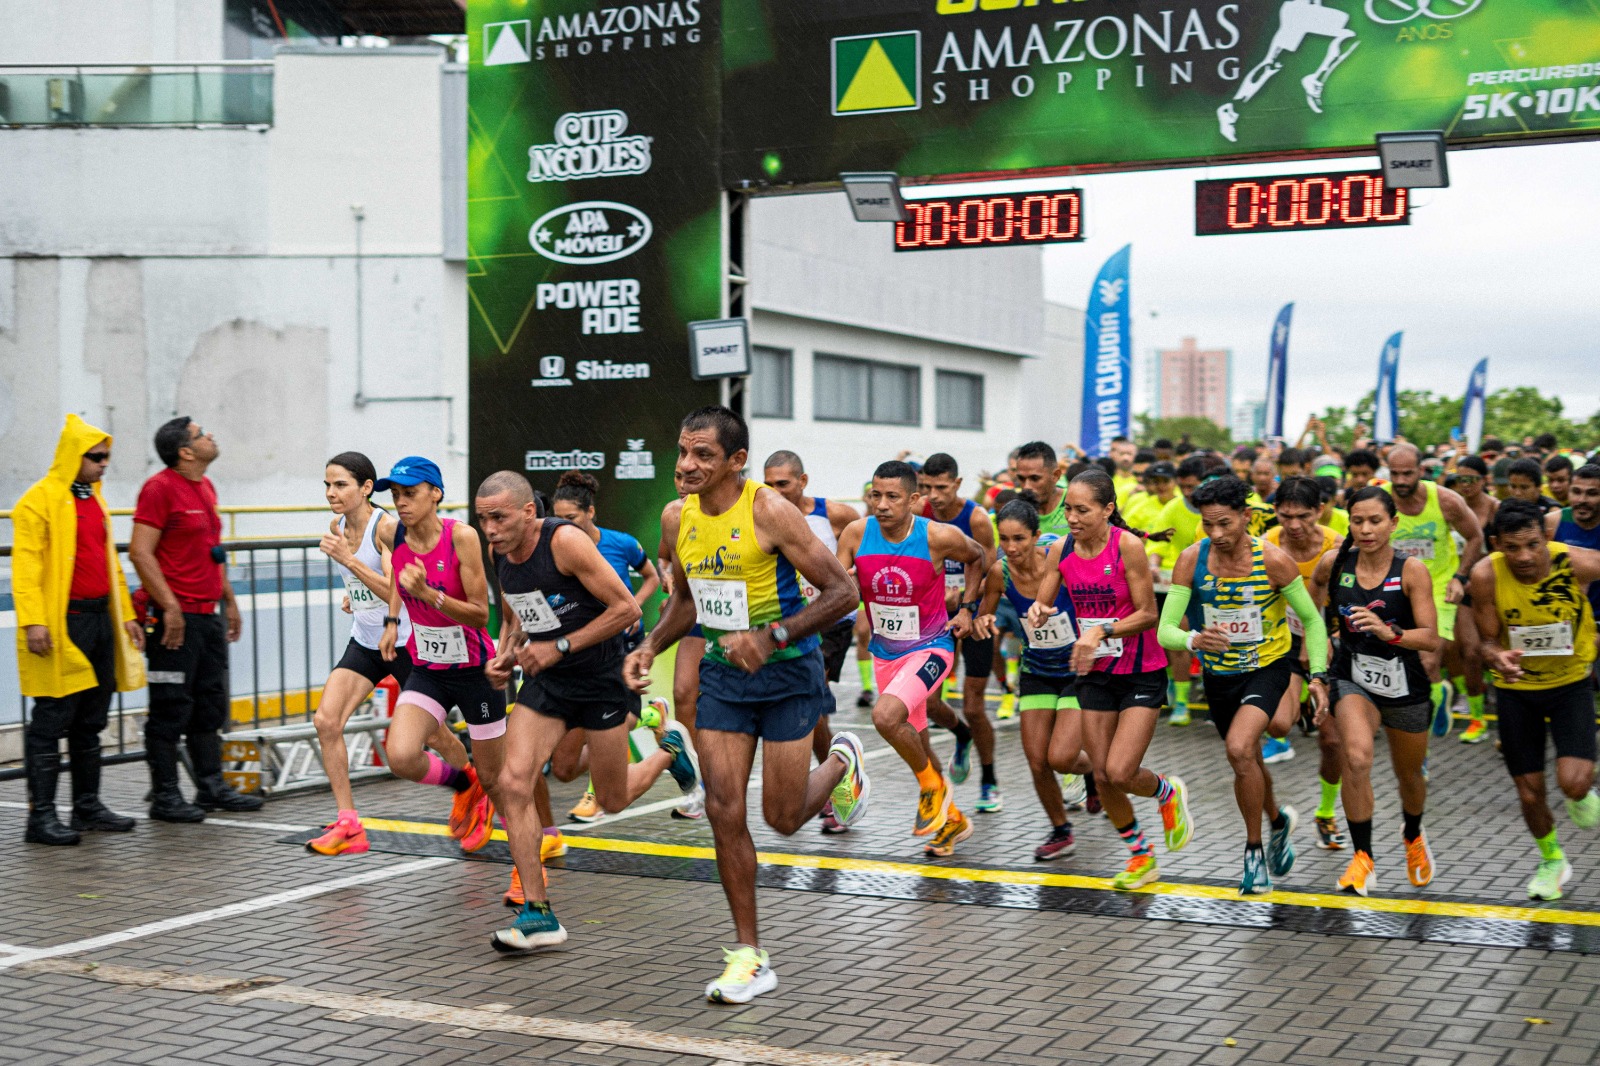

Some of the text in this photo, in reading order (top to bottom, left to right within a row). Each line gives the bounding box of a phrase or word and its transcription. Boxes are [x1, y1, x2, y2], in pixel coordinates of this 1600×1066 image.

[537, 0, 700, 42] AMAZONAS
[932, 4, 1240, 74] AMAZONAS
[1396, 23, 1453, 42] ANOS
[536, 28, 700, 60] SHOPPING
[932, 57, 1241, 104] SHOPPING
[557, 111, 627, 147] CUP
[529, 137, 650, 181] NOODLES
[1389, 159, 1434, 169] SMART
[855, 197, 890, 206] SMART
[564, 210, 610, 235] APA
[895, 194, 1079, 246] 00:00:00
[536, 279, 641, 310] POWER
[582, 306, 642, 334] ADE
[703, 344, 738, 356] SMART
[1095, 312, 1122, 397] CLAUDIA
[575, 360, 650, 380] Shizen
[526, 450, 604, 469] mentos
[886, 584, 900, 595] CT
[699, 598, 733, 616] 1483
[880, 617, 904, 631] 787
[1034, 629, 1058, 641] 871
[1523, 637, 1554, 648] 927
[423, 640, 447, 654] 797
[1364, 670, 1391, 687] 370
